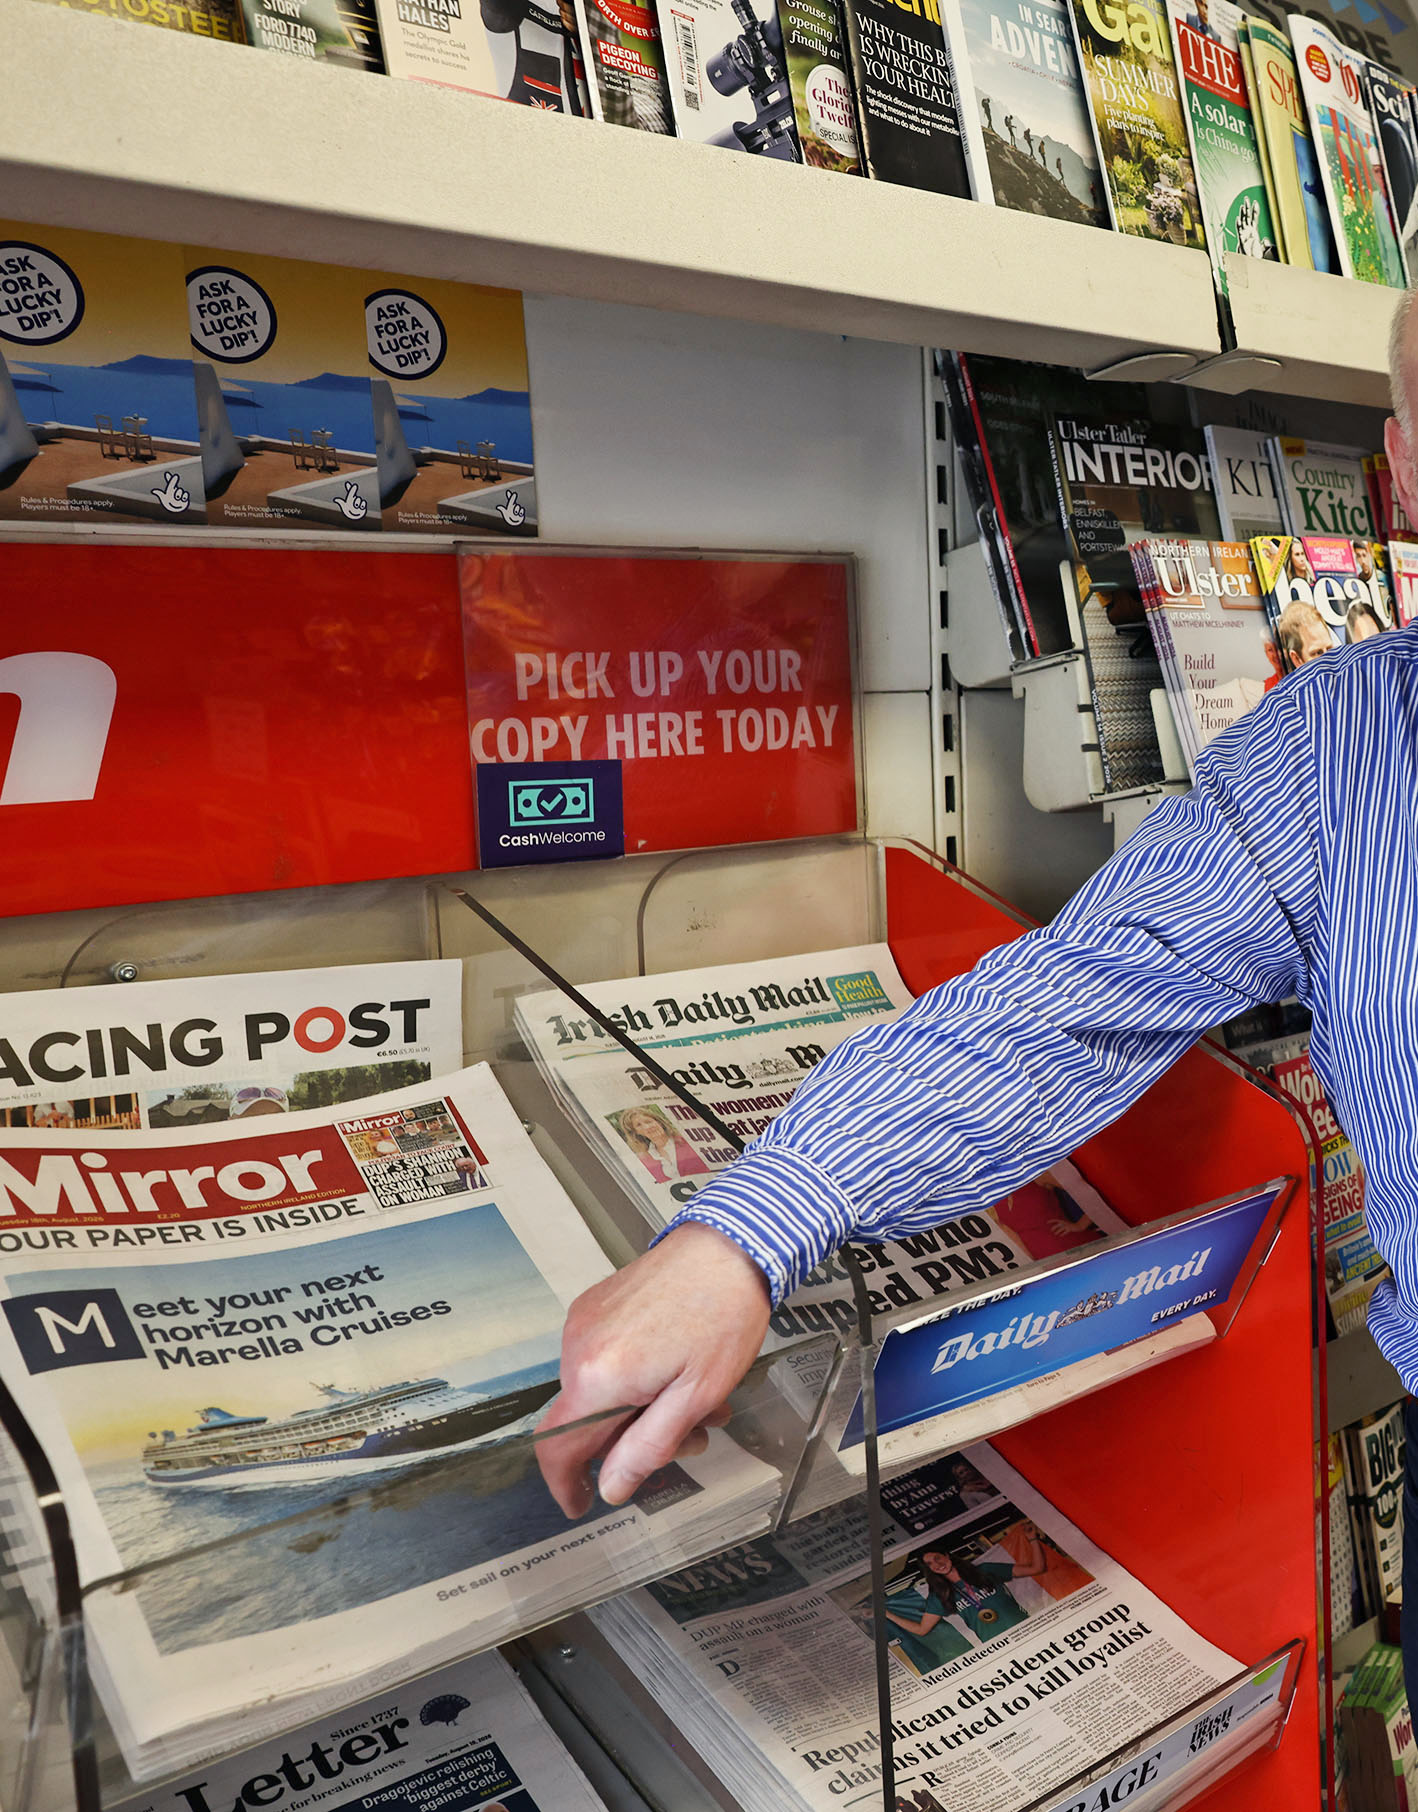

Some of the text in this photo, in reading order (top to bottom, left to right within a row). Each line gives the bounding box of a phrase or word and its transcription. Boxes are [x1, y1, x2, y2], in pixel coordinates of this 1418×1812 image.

[253, 13, 288, 33] FORD
[399, 4, 450, 32] HALES
[786, 0, 827, 20] Grouse
[260, 30, 317, 57] MODERN
[416, 31, 449, 48] Olympic
[449, 39, 467, 50] Gold
[789, 15, 838, 43] opening
[790, 31, 829, 57] finally
[856, 12, 894, 46] WHY
[897, 32, 934, 63] THIS
[599, 42, 641, 63] PIGEON
[859, 34, 950, 89] IS WRECKIN
[990, 14, 1079, 80] ADVEN
[1179, 23, 1241, 95] THE
[601, 52, 657, 79] DECOYING
[861, 55, 956, 110] YOUR HEALT
[1093, 54, 1178, 101] SUMMER
[824, 76, 849, 98] The
[1100, 78, 1150, 112] DAYS
[865, 84, 955, 126] The shock discovery that modern
[1103, 104, 1122, 120] Five
[1191, 91, 1247, 137] A solar
[198, 279, 237, 301] ASK
[196, 295, 251, 320] FOR A
[199, 310, 259, 338] LUCKY
[376, 301, 411, 322] ASK
[373, 316, 424, 339] FOR A
[377, 330, 431, 356] LUCKY
[1057, 420, 1148, 447] Ulster Tatler
[1062, 441, 1213, 492] INTERIOR
[1291, 460, 1356, 498] Country
[1078, 531, 1096, 541] AND
[1150, 544, 1249, 559] NORTHERN IRELAN
[1153, 556, 1253, 598] Ulster
[1171, 620, 1205, 629] MATTHEW
[514, 648, 803, 701] PICK UP YOUR
[1183, 653, 1216, 671] Build
[1187, 673, 1218, 690] Your
[1194, 693, 1234, 711] Dream
[471, 704, 840, 764] COPY HERE TODAY
[1199, 713, 1235, 731] Home
[499, 828, 607, 849] CashWelcome
[834, 974, 874, 992] Good
[837, 985, 885, 1004] Health
[651, 989, 756, 1026] Daily
[747, 976, 833, 1013] Mail
[244, 998, 432, 1061] POST
[344, 1113, 402, 1134] Mirror
[362, 1148, 465, 1178] DUP'S SHANNON
[367, 1160, 457, 1188] CHARGED WITH
[0, 1149, 324, 1216] Mirror
[373, 1177, 427, 1198] ASSAULT
[380, 1184, 447, 1208] ON WOMAN
[1323, 1173, 1358, 1199] SIGNS OF
[239, 1188, 347, 1212] NORTHERN IRELAND EDITION
[86, 1223, 206, 1249] PAPER
[211, 1217, 247, 1240] IS
[255, 1197, 367, 1234] INSIDE
[911, 1241, 1019, 1295] PM?
[132, 1296, 201, 1320] eet
[203, 1285, 293, 1319] your
[300, 1264, 386, 1296] next
[1150, 1289, 1217, 1324] EVERY DAY.
[140, 1291, 378, 1346] horizon with
[930, 1247, 1213, 1376] Daily Mail
[155, 1298, 454, 1372] Marella Cruises
[1365, 1426, 1397, 1488] BIG
[881, 1479, 922, 1501] think
[900, 1484, 961, 1518] Travers?
[436, 1513, 638, 1603] Set sail on your next story
[655, 1548, 774, 1599] NEWS
[956, 1586, 998, 1613] IREAND
[689, 1594, 827, 1644] DUP MP charged with
[699, 1609, 821, 1652] assault on a woman
[921, 1635, 1012, 1688] Medal detector
[956, 1639, 1067, 1710] dissident
[1062, 1602, 1132, 1653] group
[917, 1736, 943, 1761] it
[940, 1706, 1004, 1749] tried
[1001, 1693, 1032, 1718] to
[1025, 1659, 1074, 1702] kill
[1064, 1618, 1154, 1679] loyalist
[329, 1705, 401, 1744] Since 1737
[1186, 1718, 1232, 1759] NEWS
[1190, 1704, 1234, 1744] IRISH
[174, 1715, 412, 1812] Letter
[361, 1748, 495, 1810] Dragojevic relishing
[289, 1756, 408, 1812] for breaking news
[419, 1768, 509, 1812] against Celtic
